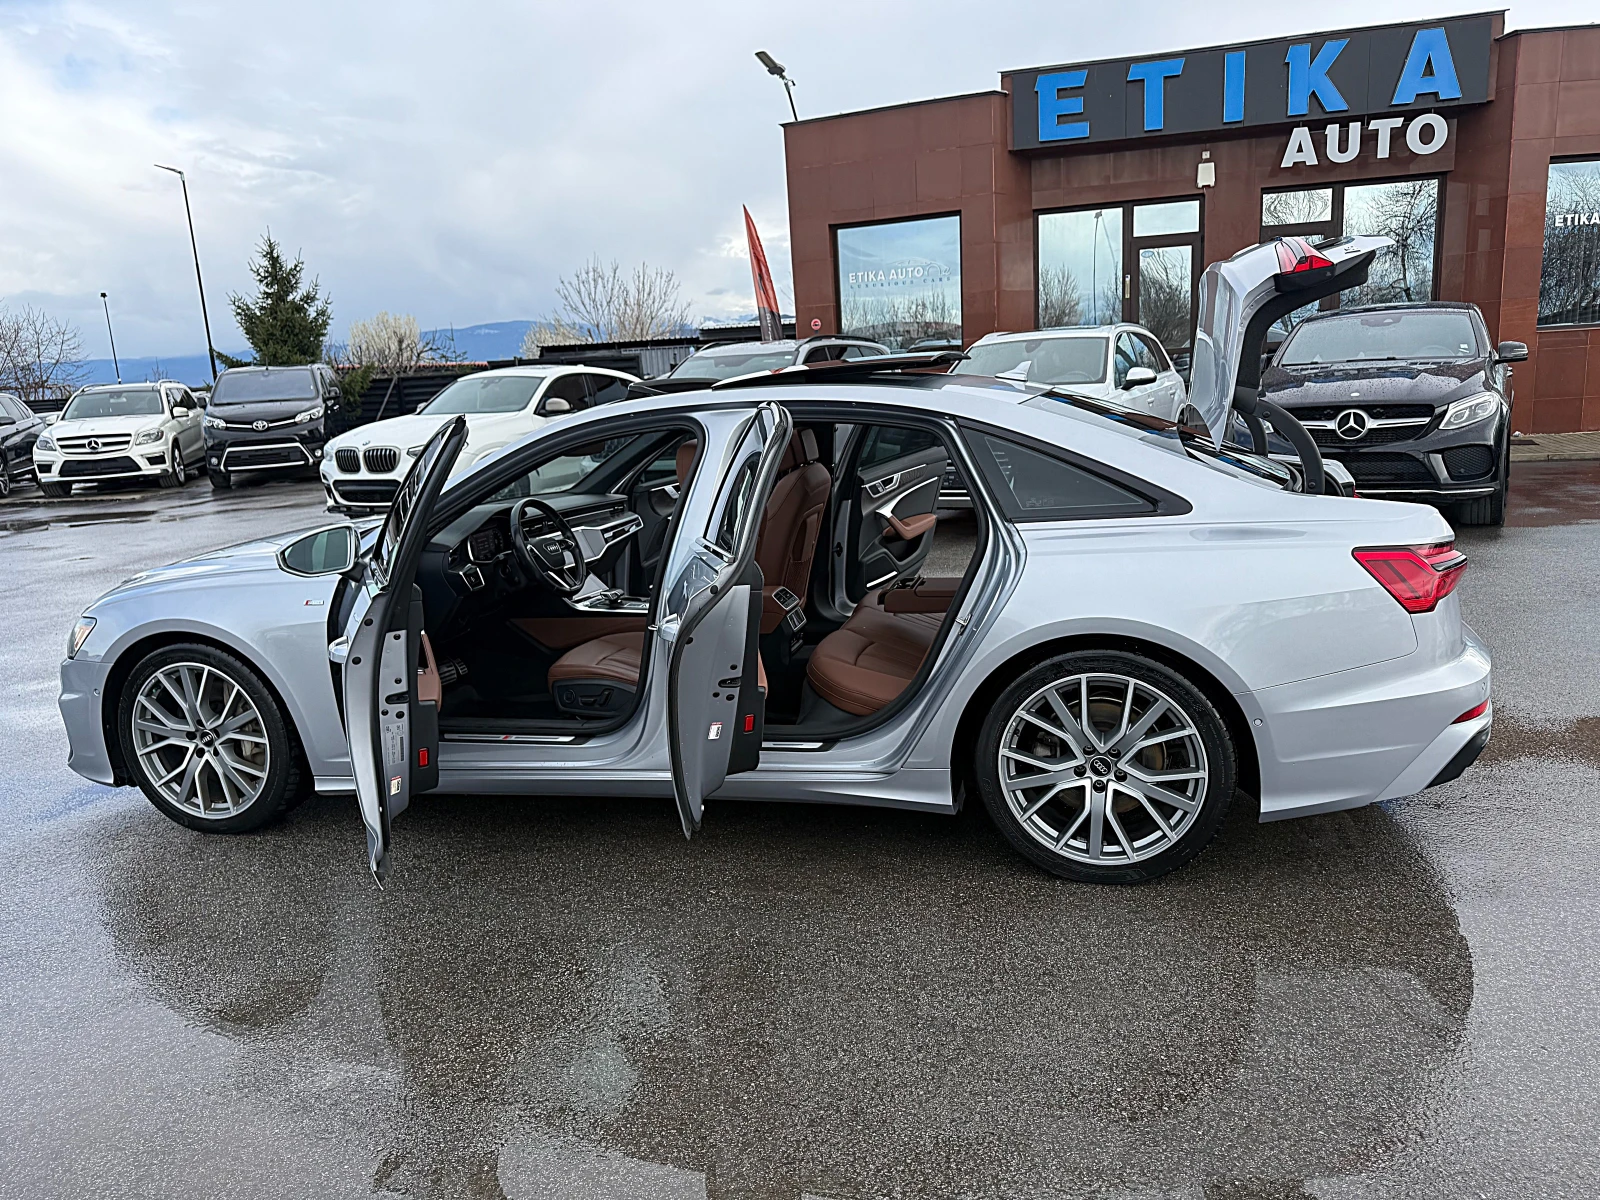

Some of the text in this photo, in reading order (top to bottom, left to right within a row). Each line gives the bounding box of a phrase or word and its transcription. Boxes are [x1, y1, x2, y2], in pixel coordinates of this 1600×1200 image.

[1034, 26, 1463, 142] ETIKA
[1280, 114, 1448, 168] AUTO
[1554, 212, 1600, 227] ETIKA
[849, 266, 924, 284] ETIKA AUTO
[850, 280, 914, 289] LUXURIOUS
